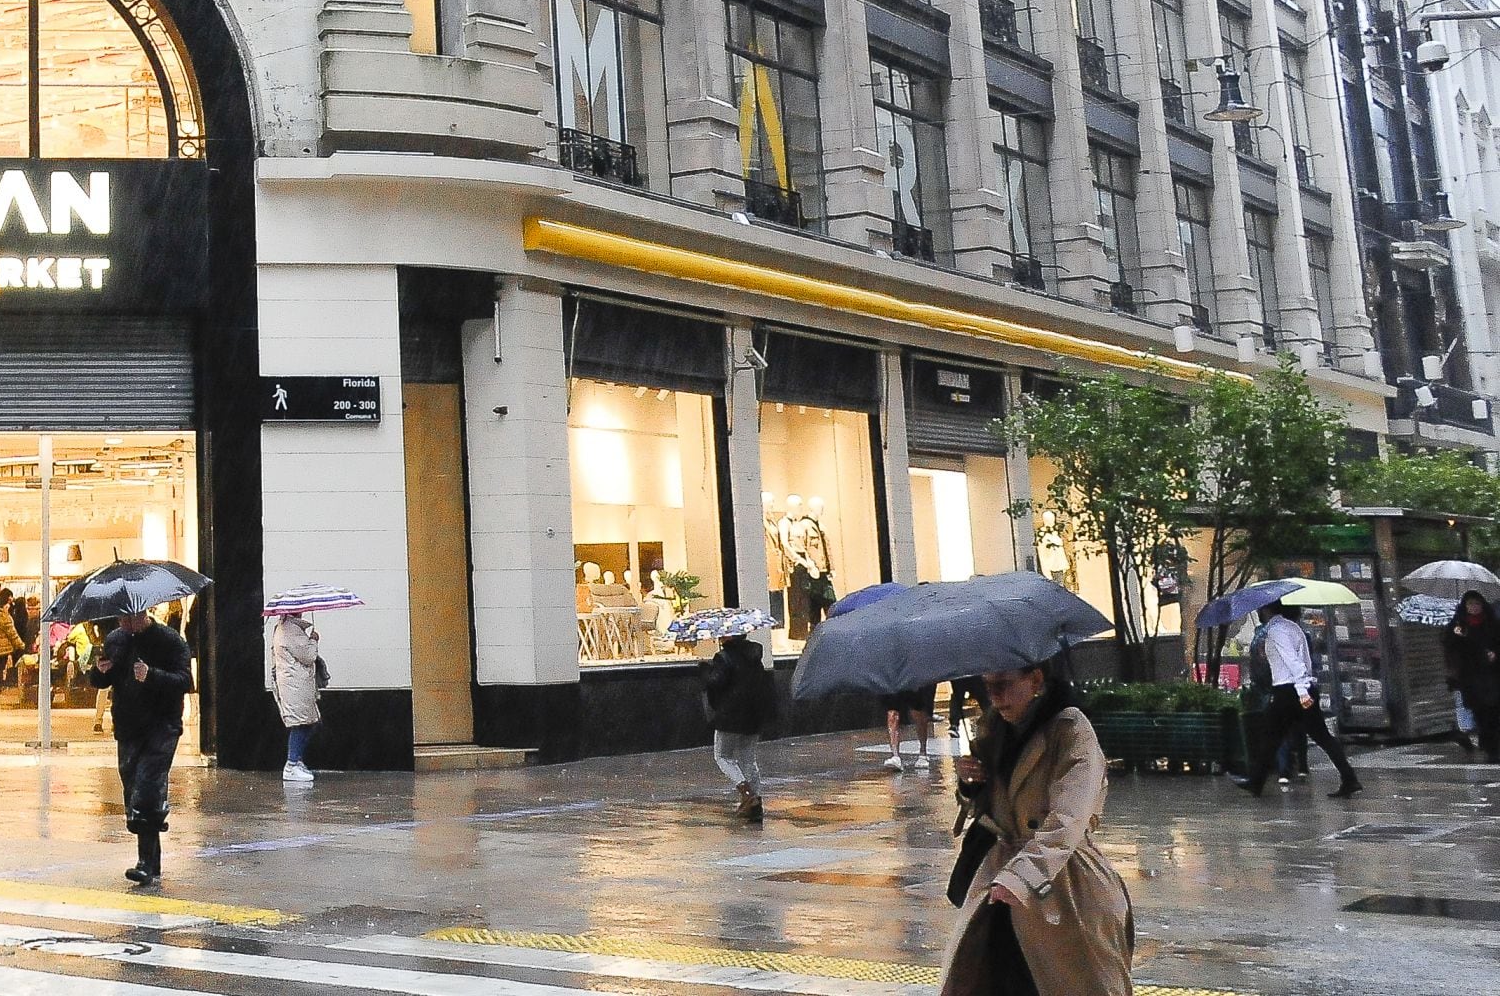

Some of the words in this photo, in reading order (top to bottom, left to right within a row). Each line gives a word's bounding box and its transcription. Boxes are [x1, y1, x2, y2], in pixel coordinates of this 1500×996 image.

[342, 378, 376, 388] Florida
[333, 400, 351, 410] 200
[359, 400, 376, 410] 300
